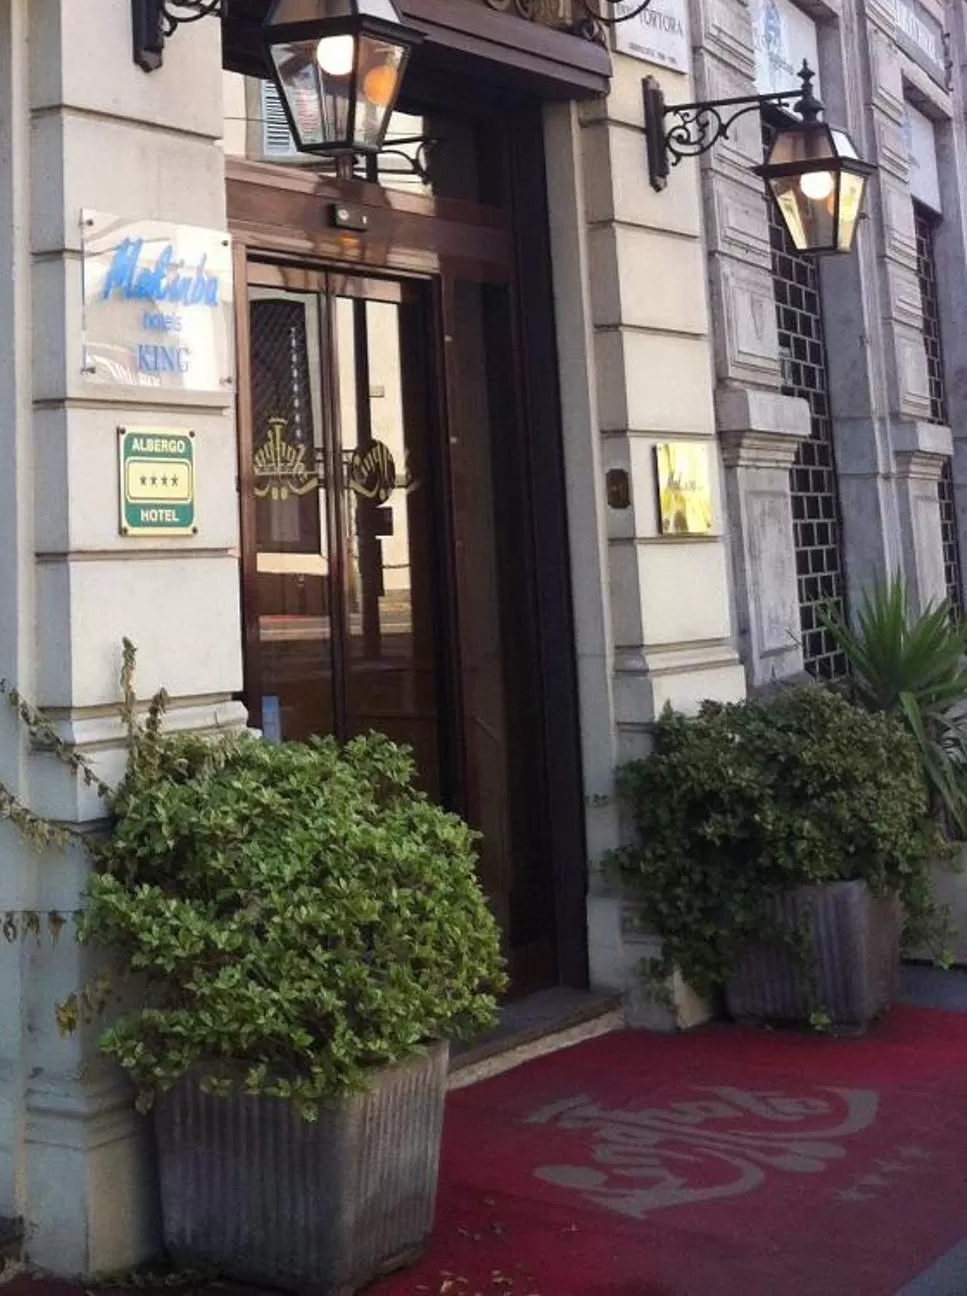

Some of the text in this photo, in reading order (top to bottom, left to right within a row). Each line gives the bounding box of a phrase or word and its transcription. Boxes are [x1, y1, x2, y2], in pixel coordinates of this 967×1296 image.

[137, 343, 190, 373] KING
[131, 437, 186, 454] ALBERGO
[140, 508, 180, 523] HOTEL
